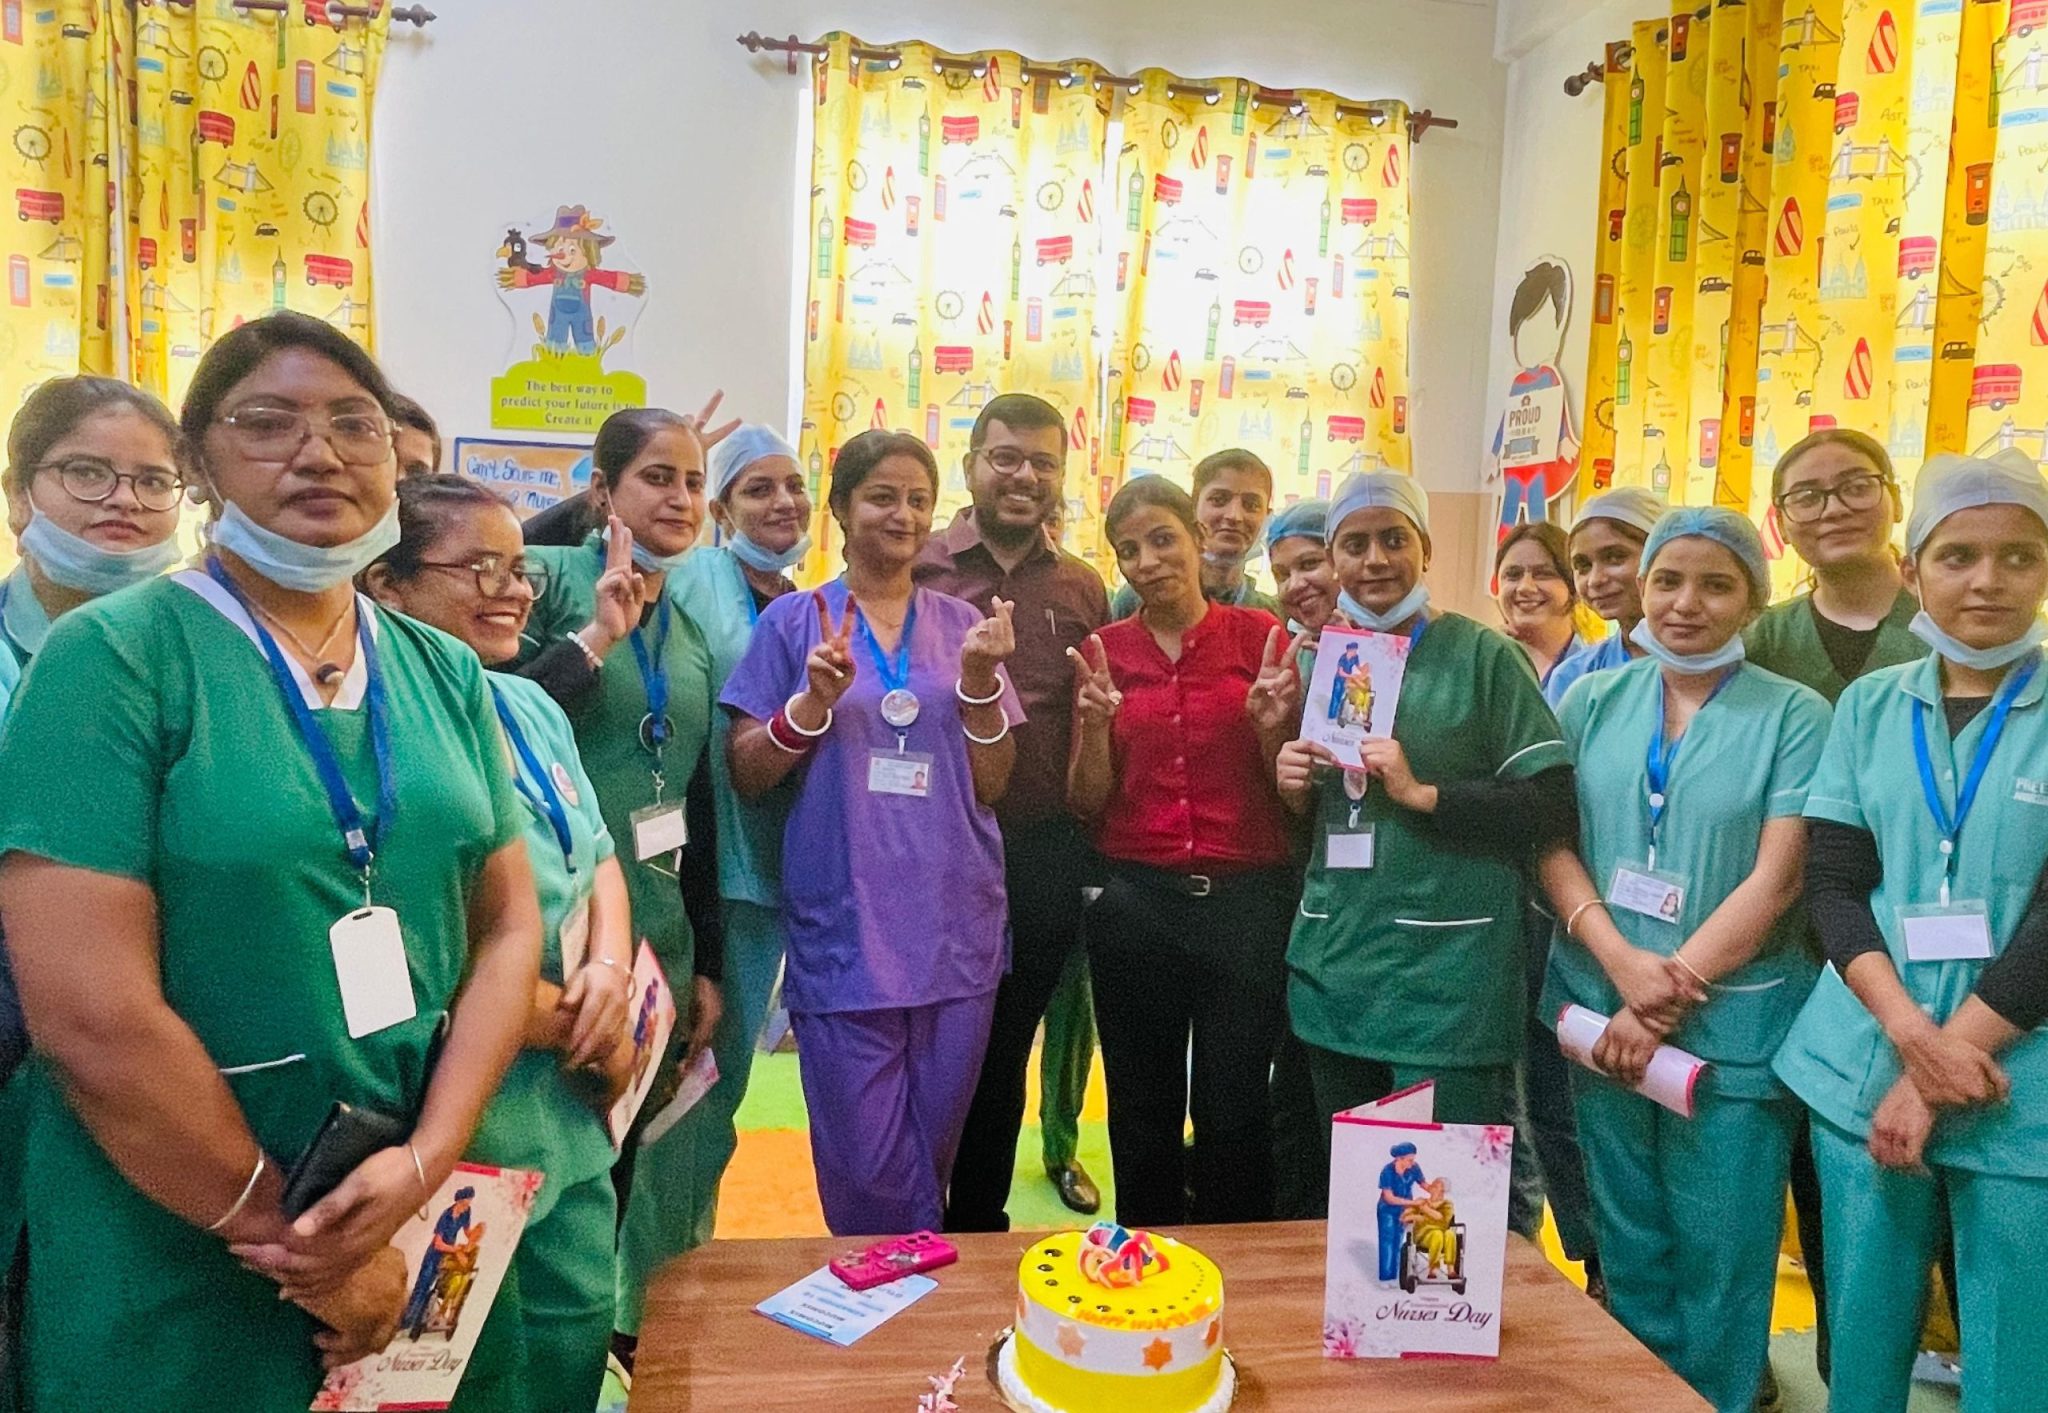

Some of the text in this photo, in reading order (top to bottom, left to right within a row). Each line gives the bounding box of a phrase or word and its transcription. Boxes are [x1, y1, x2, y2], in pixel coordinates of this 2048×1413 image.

[526, 381, 613, 395] The best way to
[500, 396, 541, 408] predict
[545, 399, 571, 409] your
[575, 399, 609, 410] future
[545, 413, 593, 425] Create it
[1509, 406, 1541, 428] PROUD
[1375, 1300, 1493, 1330] Nurses Day
[426, 1349, 463, 1378] Day
